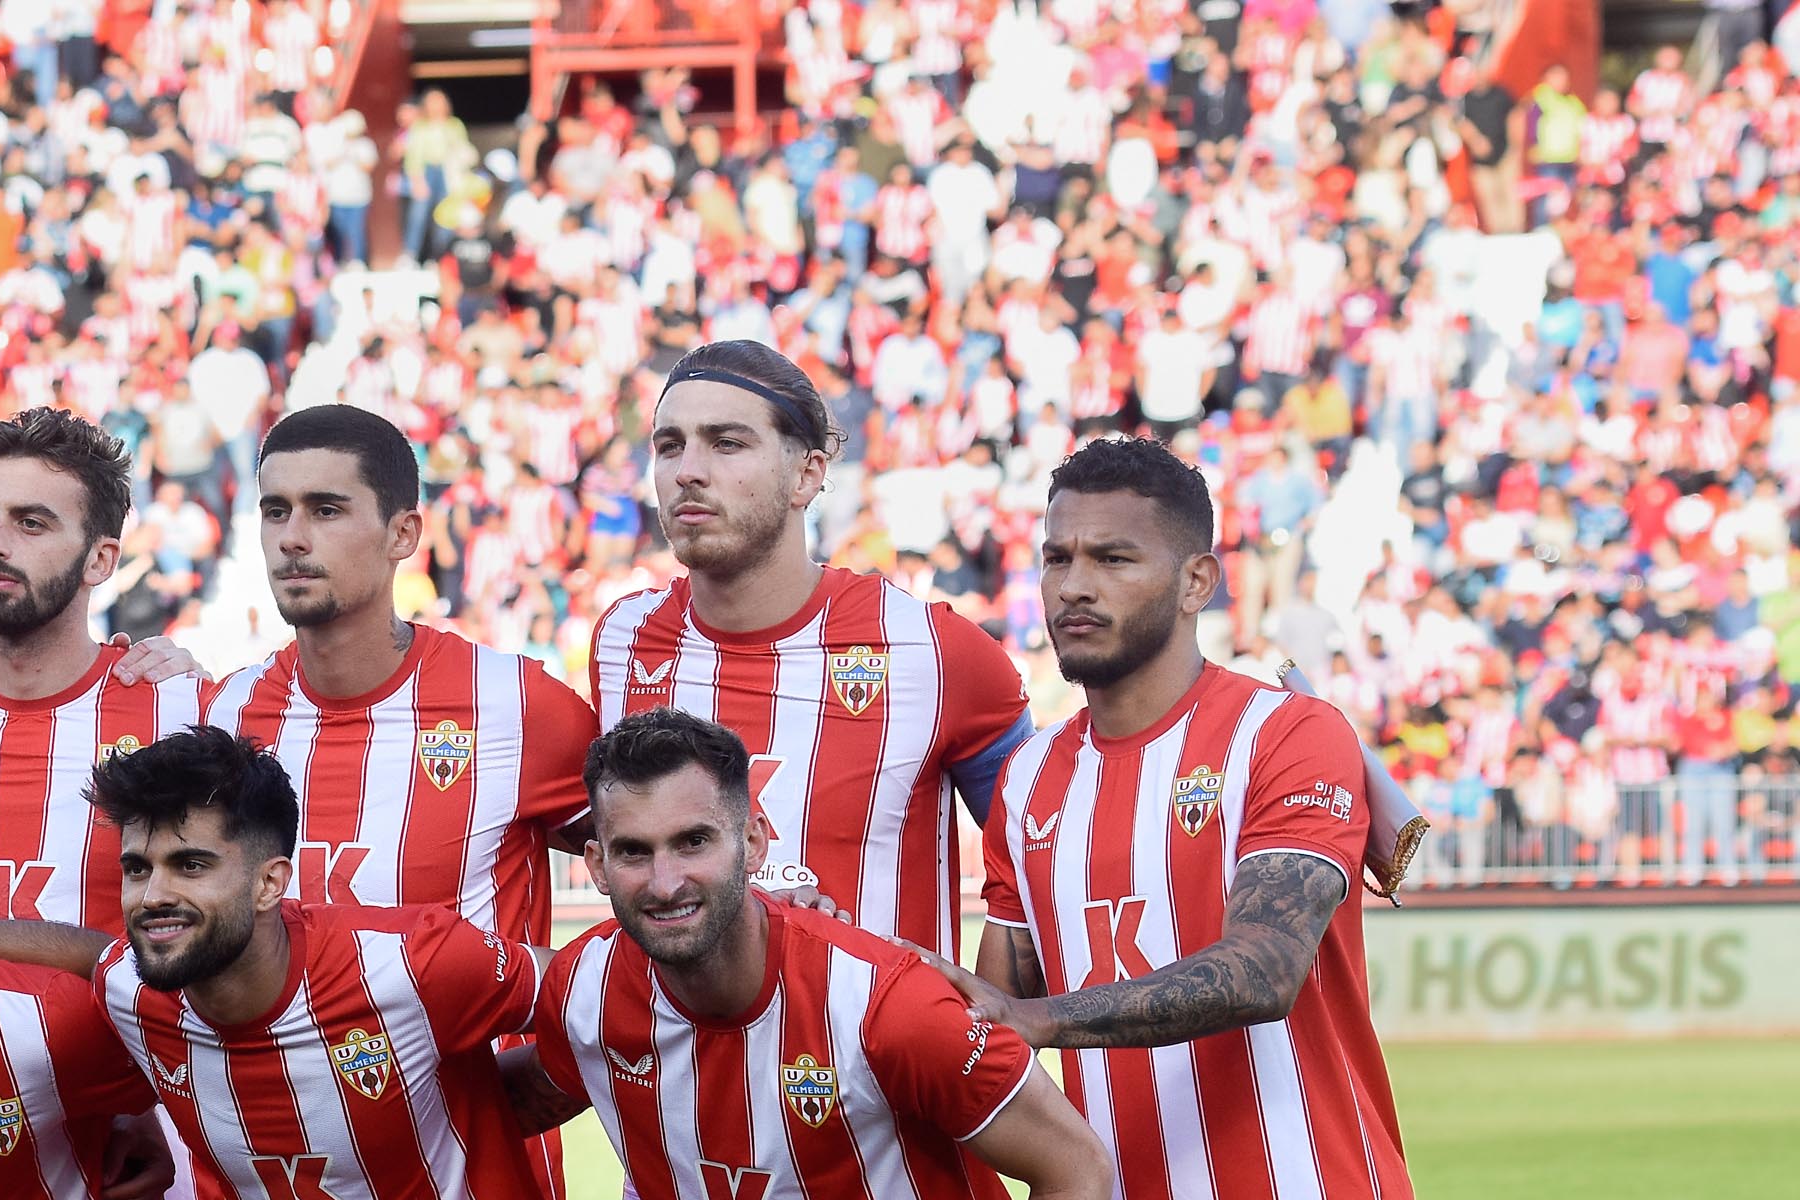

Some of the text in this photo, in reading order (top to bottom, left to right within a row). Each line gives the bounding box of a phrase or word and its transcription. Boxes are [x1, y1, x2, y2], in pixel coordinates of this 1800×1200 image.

[837, 658, 881, 667] U D
[631, 687, 667, 695] CASTORE
[425, 735, 467, 744] U D
[1180, 778, 1217, 790] U D
[1283, 793, 1329, 809] العروس
[1409, 929, 1747, 1011] HOASIS
[338, 1040, 381, 1058] U D
[615, 1071, 653, 1089] CASTORE
[787, 1071, 828, 1081] U D
[159, 1080, 191, 1099] CASTORE
[1, 1104, 13, 1113] D
